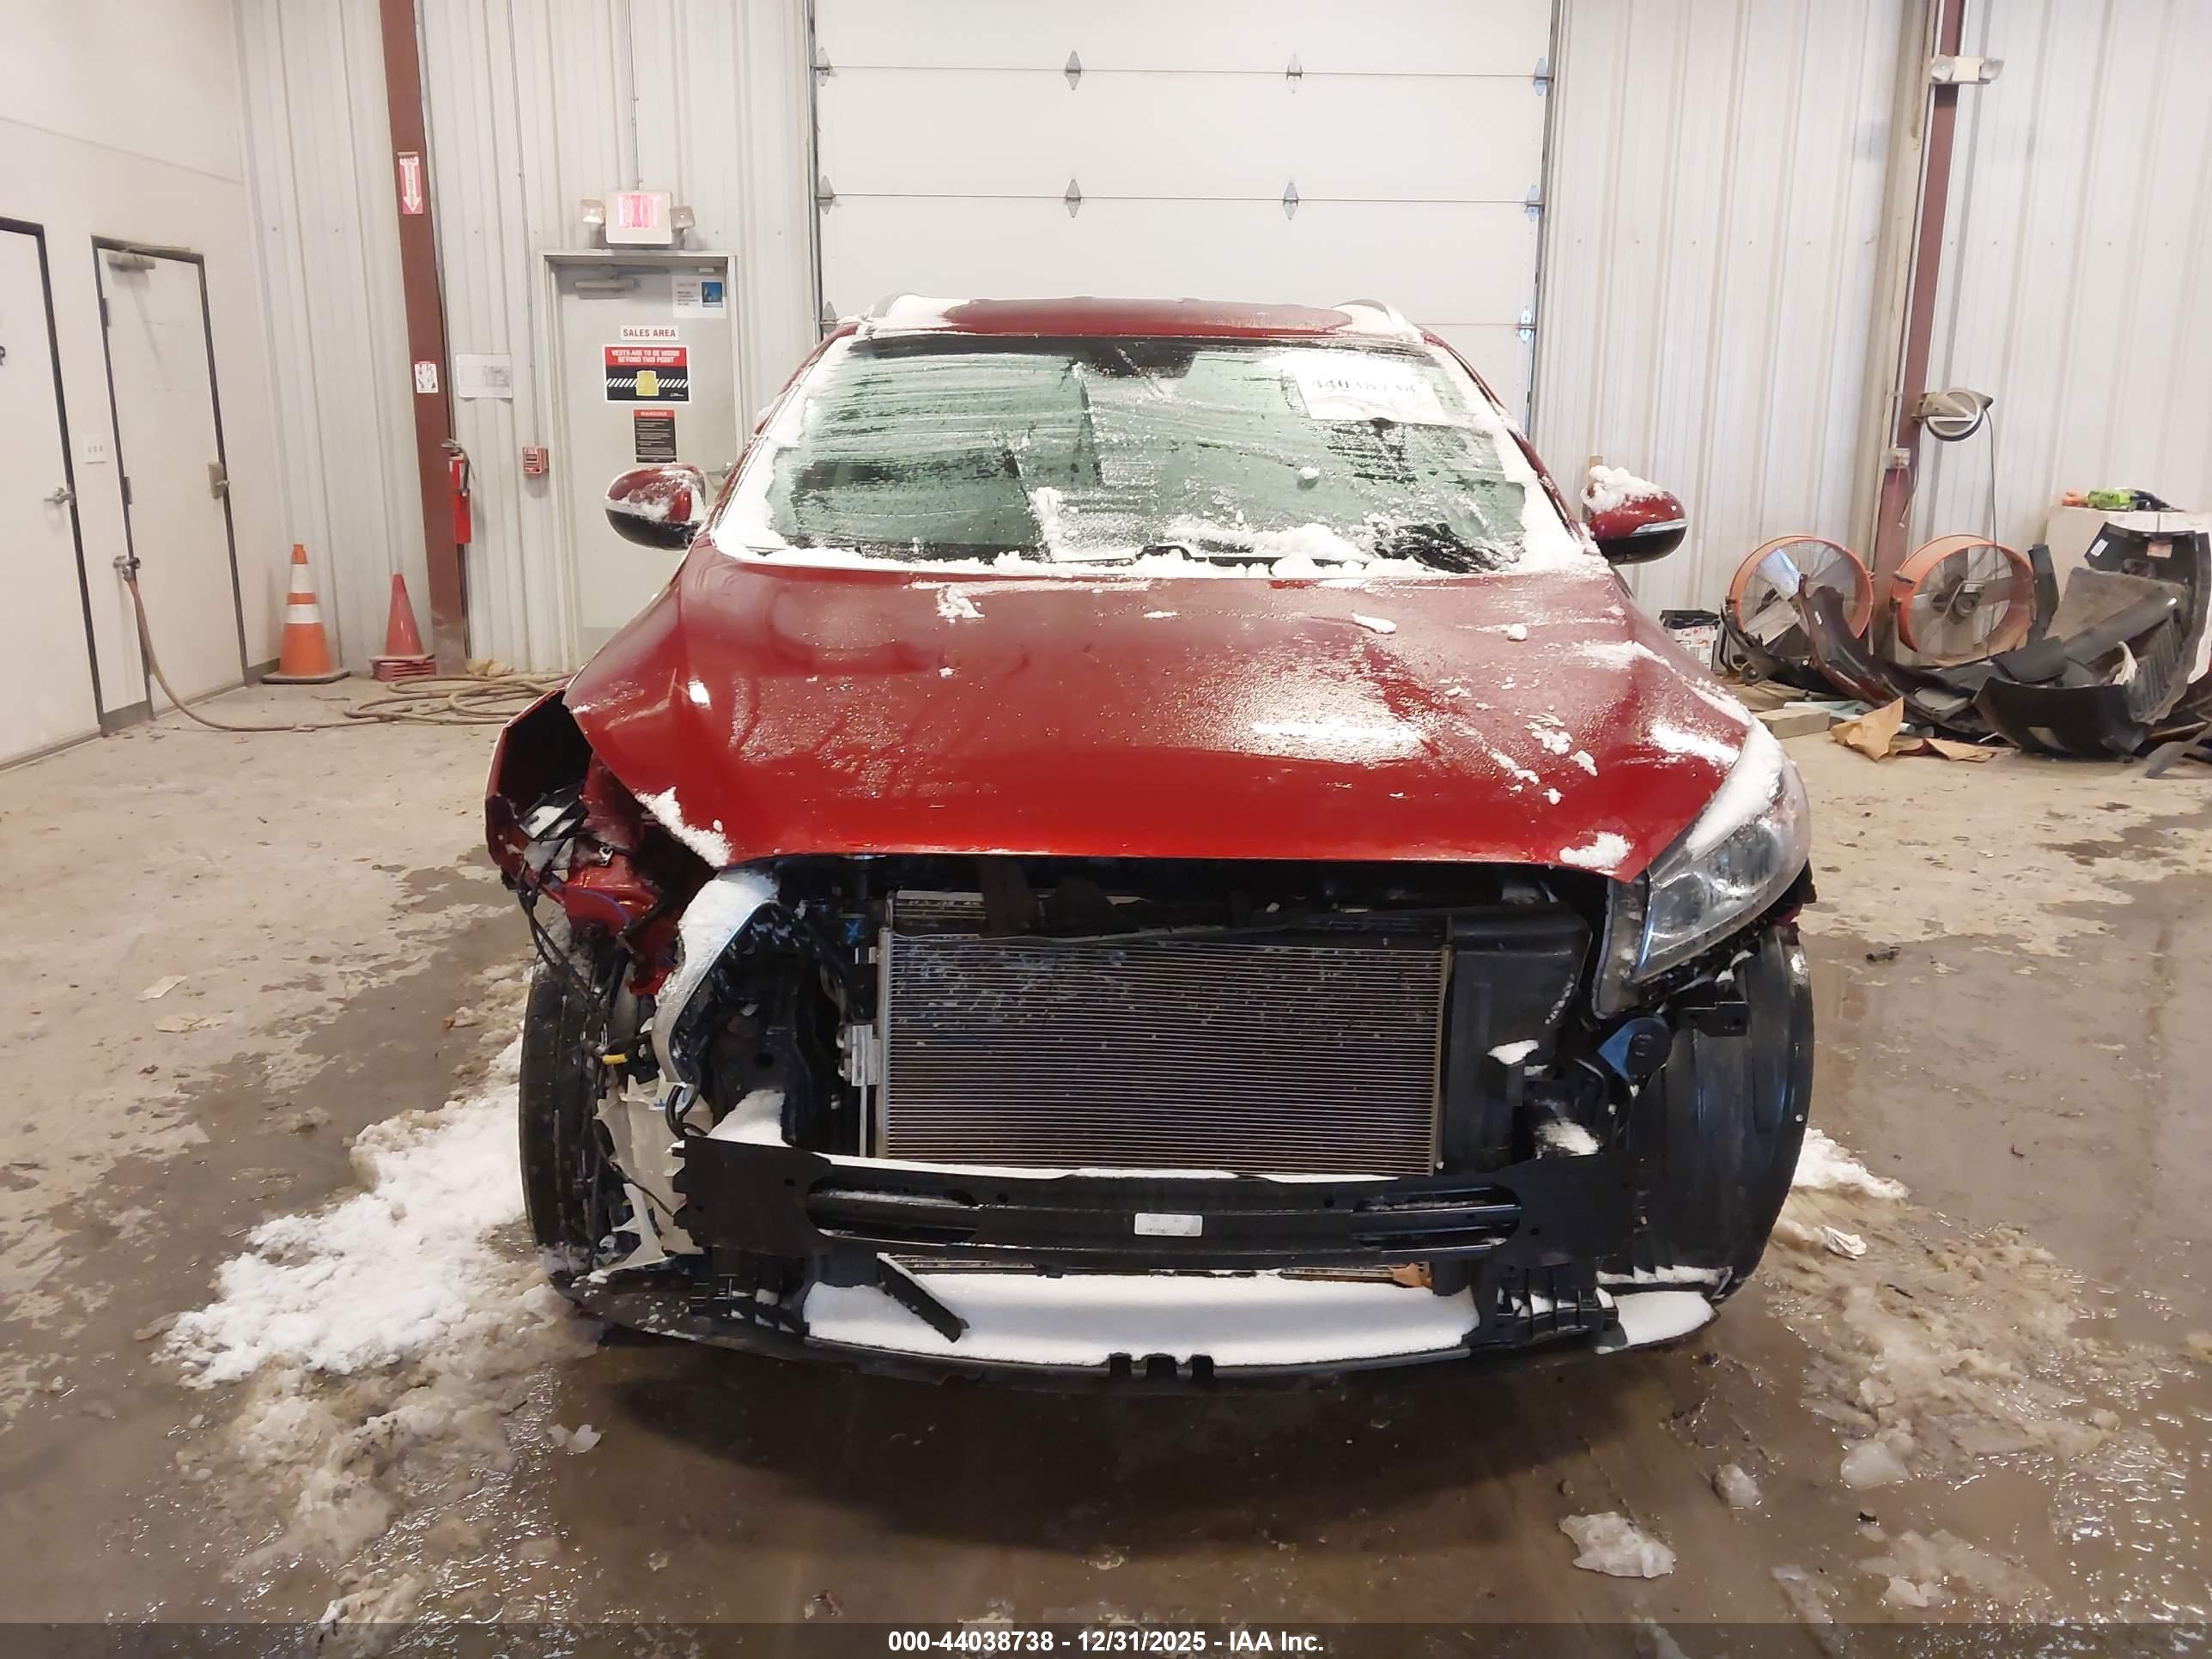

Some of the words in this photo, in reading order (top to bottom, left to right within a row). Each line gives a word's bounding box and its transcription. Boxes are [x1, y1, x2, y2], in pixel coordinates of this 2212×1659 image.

[617, 194, 659, 229] EXIT
[623, 329, 650, 337] SALES
[653, 329, 676, 337] AREA
